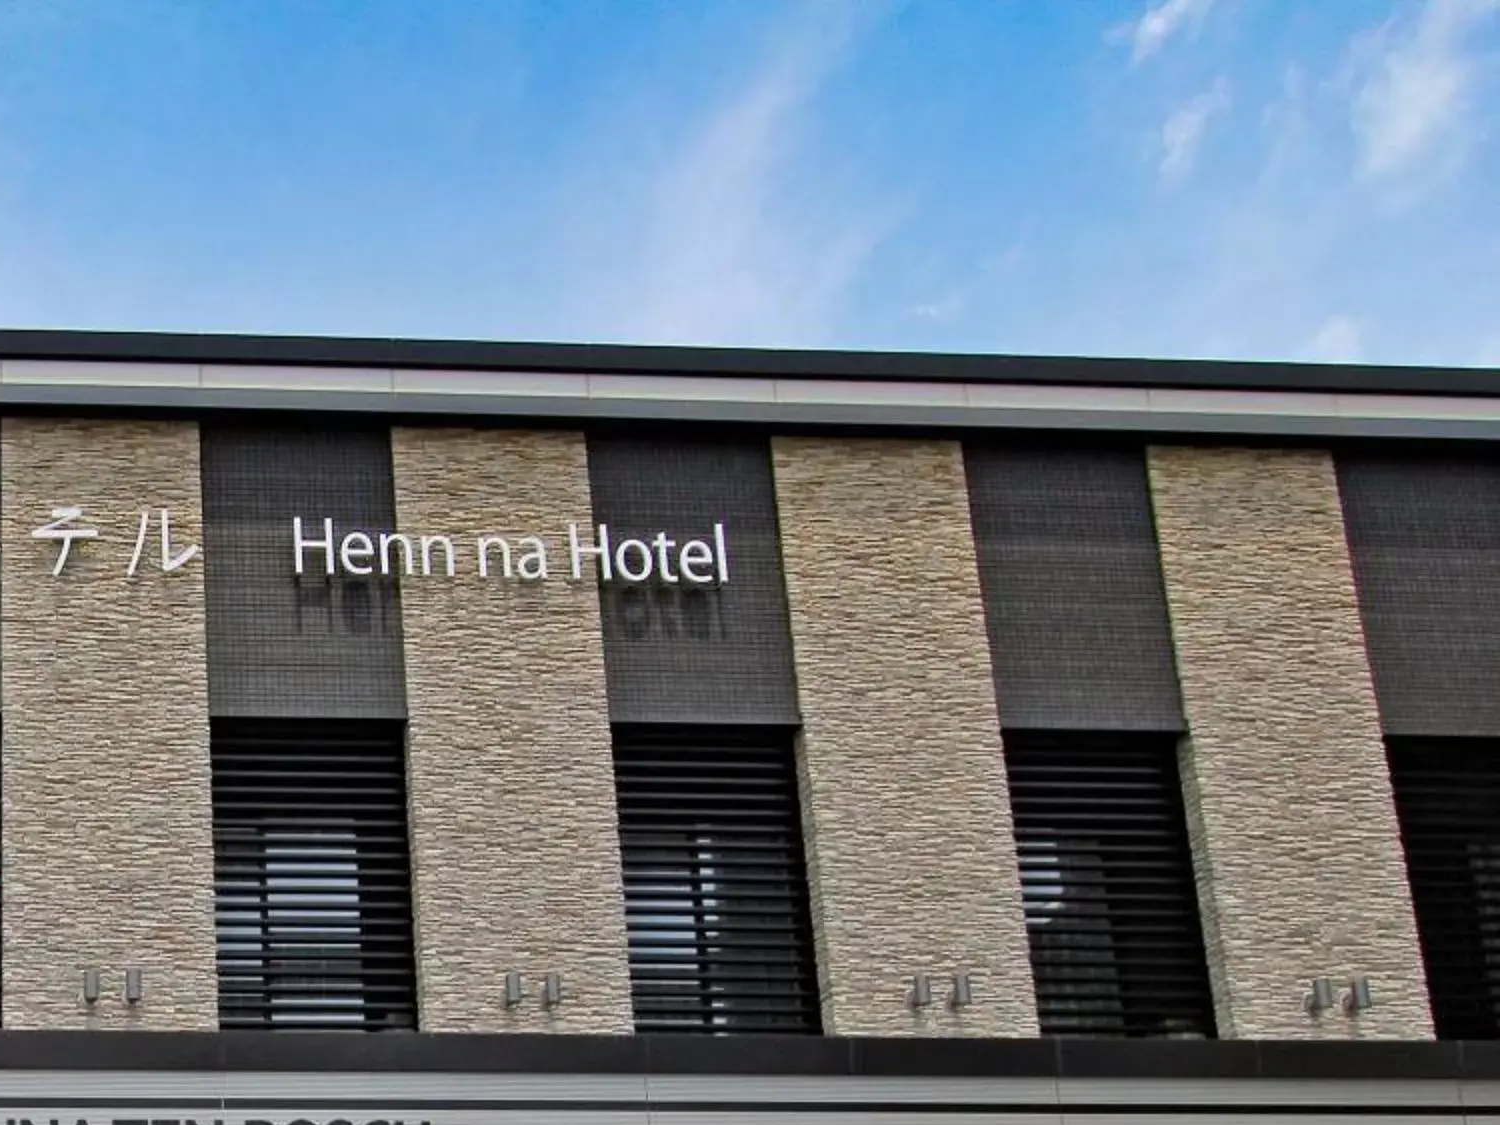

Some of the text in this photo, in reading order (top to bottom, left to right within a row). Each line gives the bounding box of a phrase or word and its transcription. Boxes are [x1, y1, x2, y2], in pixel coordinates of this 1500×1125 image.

[292, 516, 730, 584] Henn na Hotel
